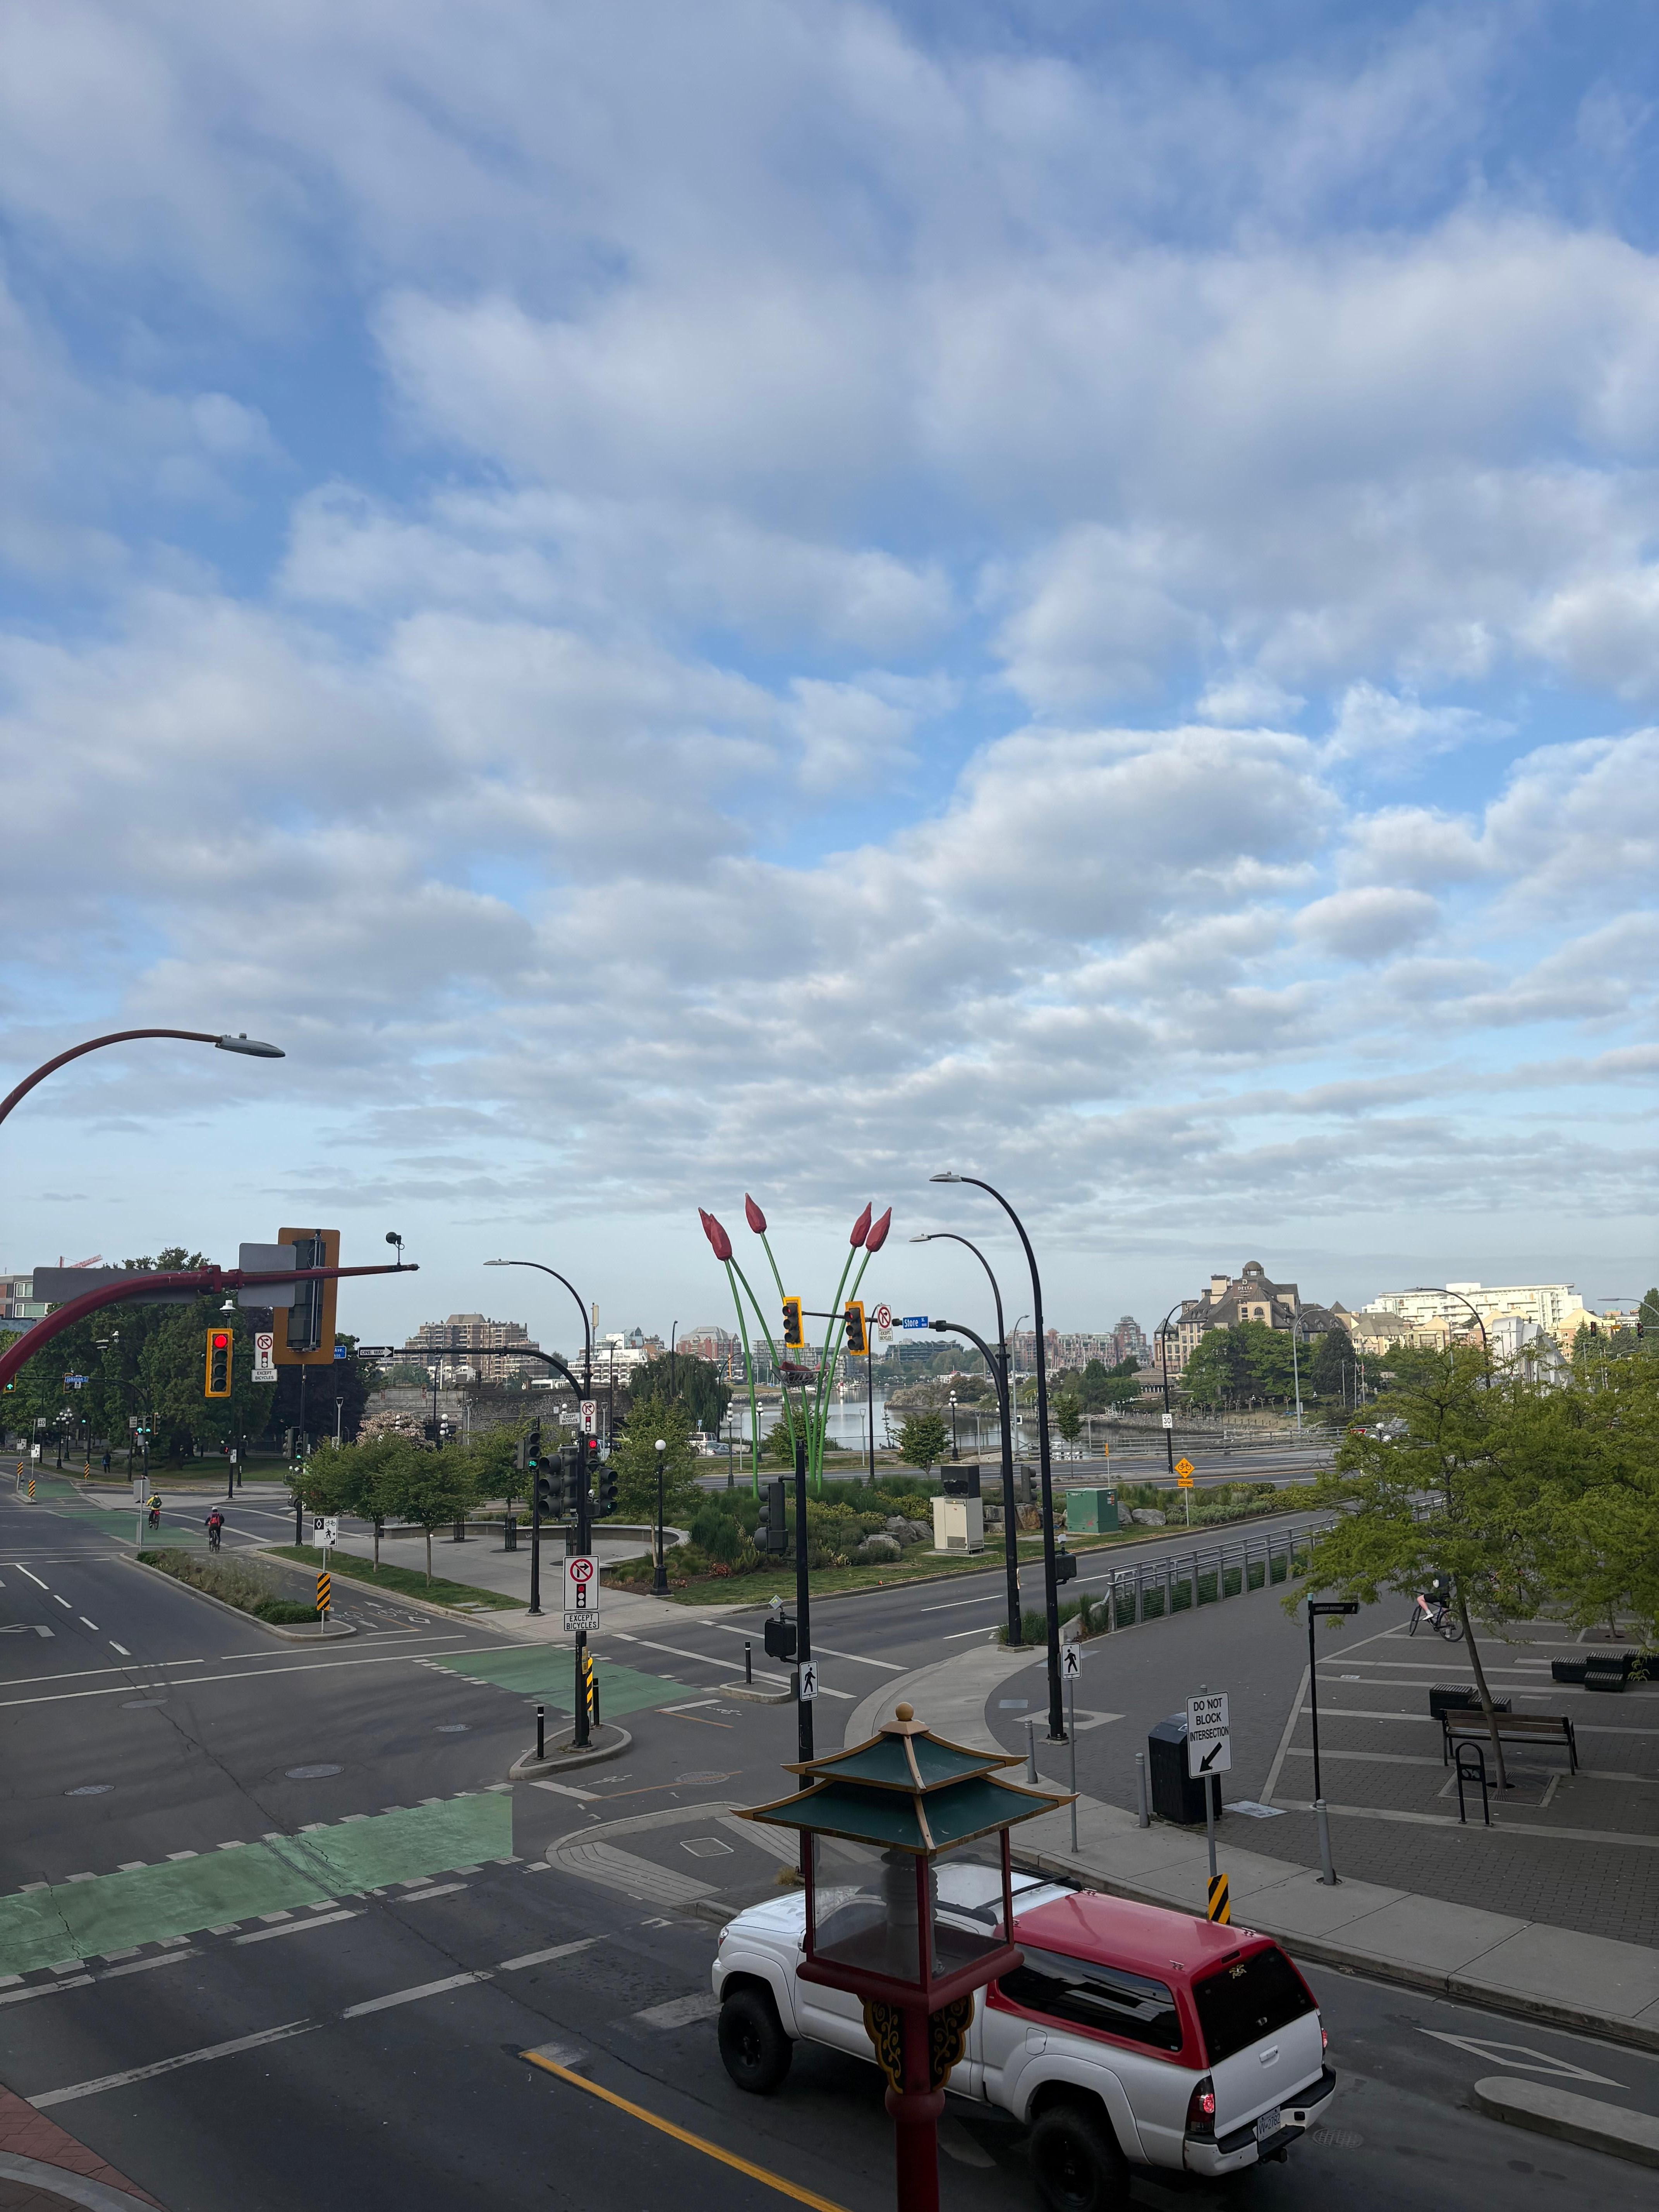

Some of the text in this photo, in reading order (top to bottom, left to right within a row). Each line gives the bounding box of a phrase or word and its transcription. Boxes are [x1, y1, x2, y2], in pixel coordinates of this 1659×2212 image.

[904, 1319, 919, 1327] Store
[567, 1621, 596, 1630] BICYCLES
[1194, 1698, 1223, 1711] DO NOT
[1196, 1712, 1222, 1726] BLOCK
[1190, 1726, 1229, 1741] INTERSECTION
